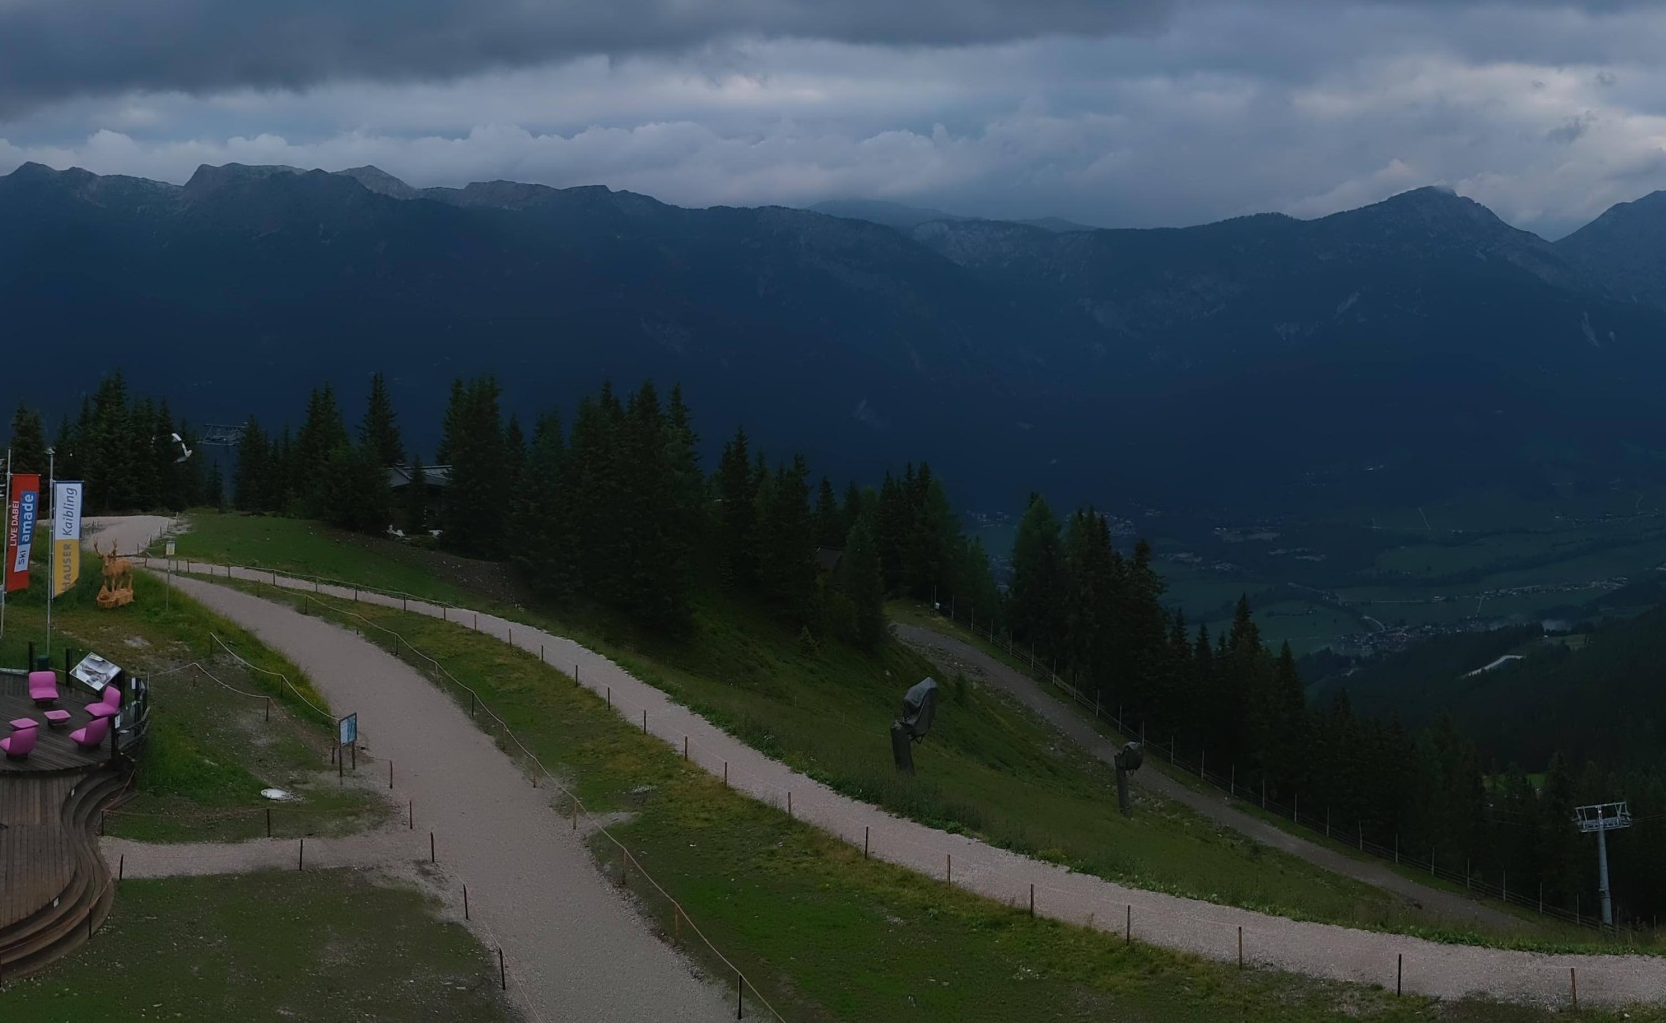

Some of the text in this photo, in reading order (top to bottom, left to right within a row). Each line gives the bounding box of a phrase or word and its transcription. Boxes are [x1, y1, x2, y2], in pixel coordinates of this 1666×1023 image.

[10, 500, 19, 547] LIVE DABEI
[61, 487, 78, 594] HAUSER Kaibling
